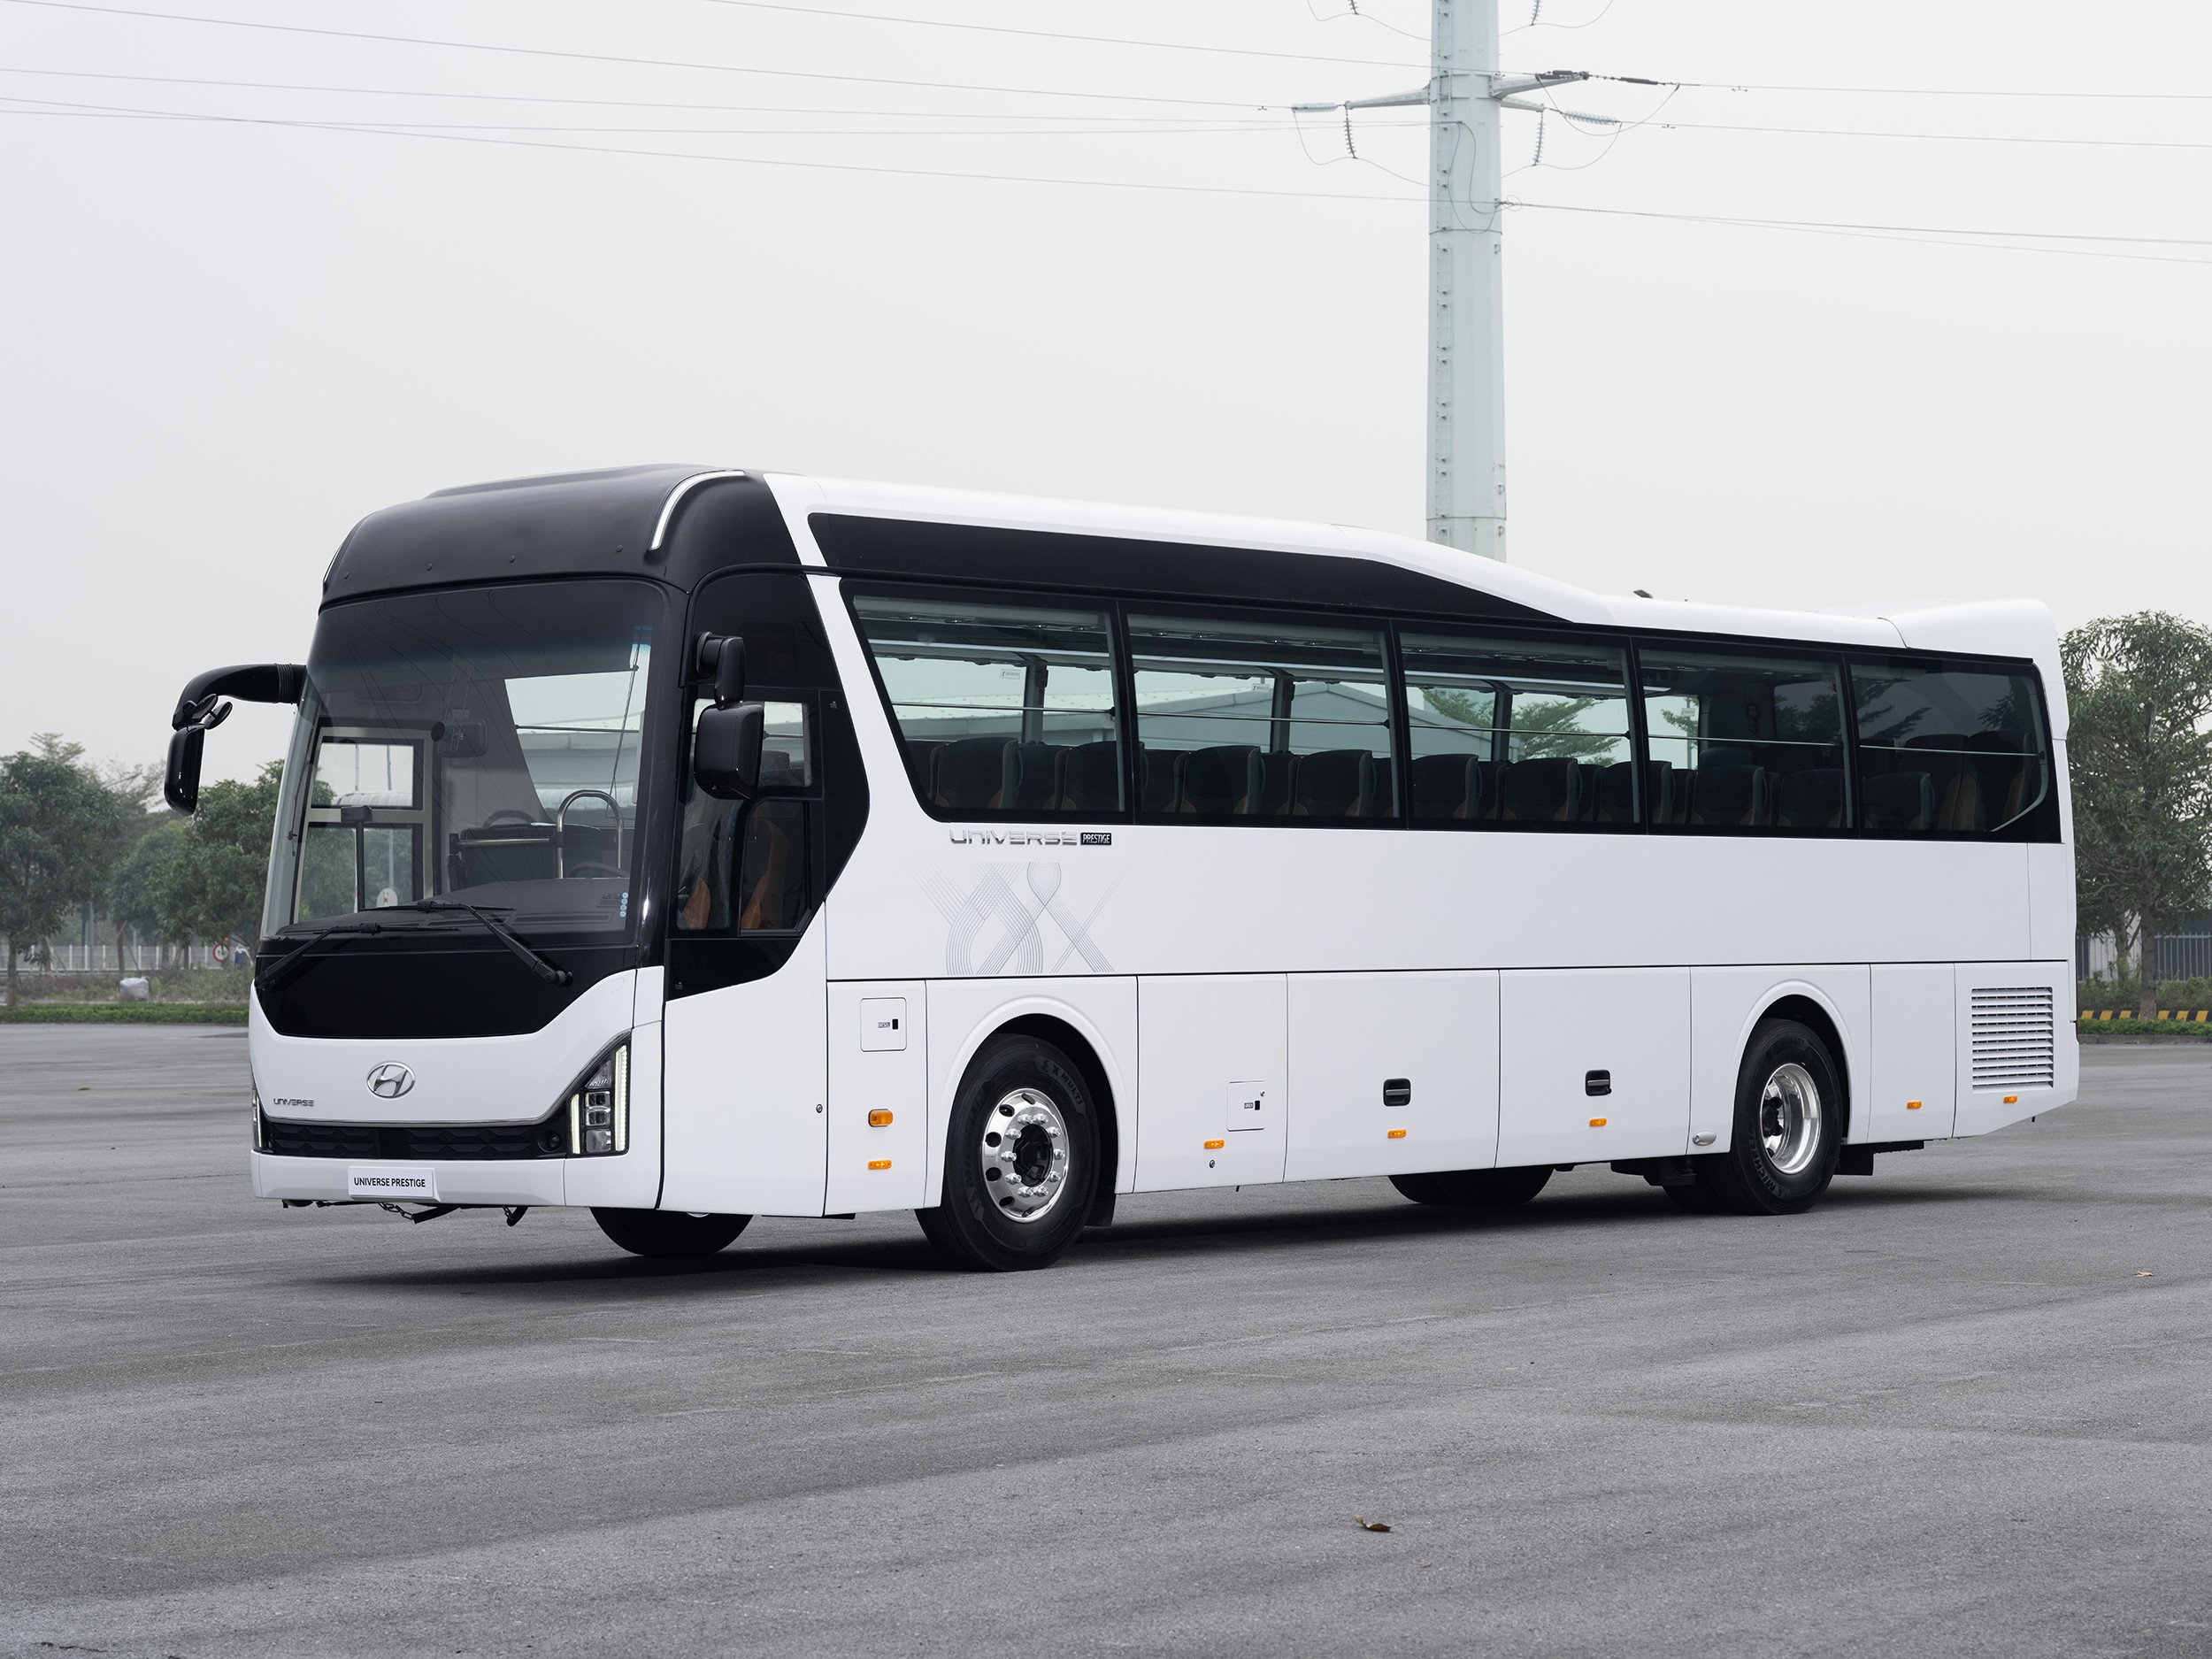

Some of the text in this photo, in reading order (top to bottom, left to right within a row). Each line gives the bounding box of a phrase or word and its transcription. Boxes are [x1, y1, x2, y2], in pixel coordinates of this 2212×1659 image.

[949, 830, 1110, 845] UNIVERSE PRESTIGE
[1061, 1072, 1083, 1105] MULTI
[273, 1098, 314, 1107] UNIVERSE
[354, 1177, 426, 1187] UNIVERSE PRESTIGE
